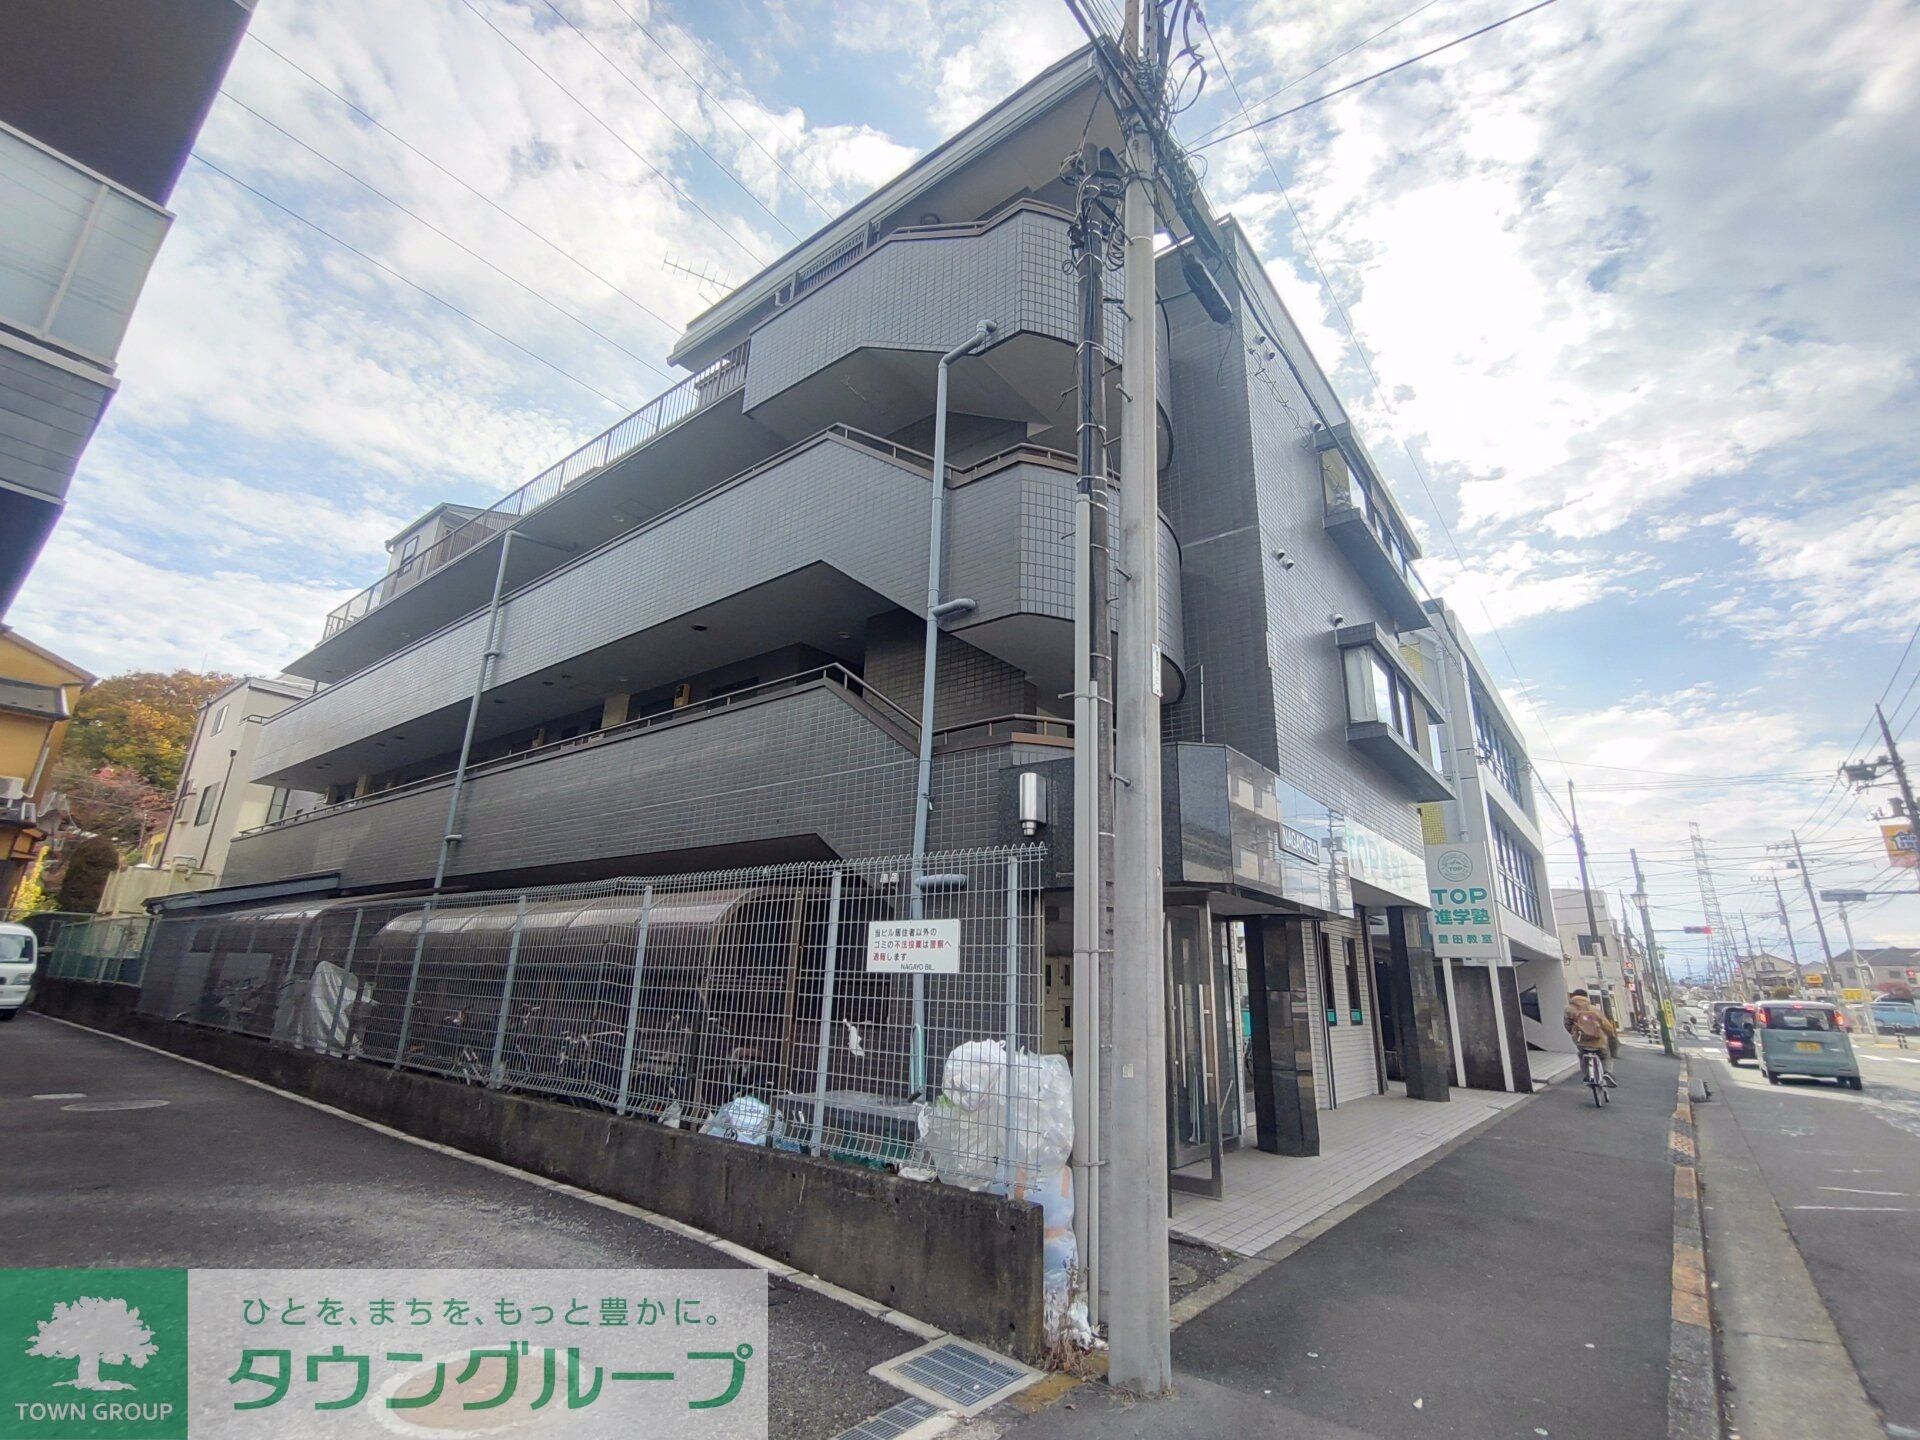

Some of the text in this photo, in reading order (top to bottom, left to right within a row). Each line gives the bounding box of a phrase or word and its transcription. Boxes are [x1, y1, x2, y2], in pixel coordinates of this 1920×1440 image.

[1431, 888, 1488, 905] TOP
[1434, 908, 1491, 925] 進学塾
[875, 928, 937, 938] 当ビル居住者以外の
[874, 939, 952, 949] ゴミの不法投棄は警察へ
[873, 952, 907, 962] 通報します
